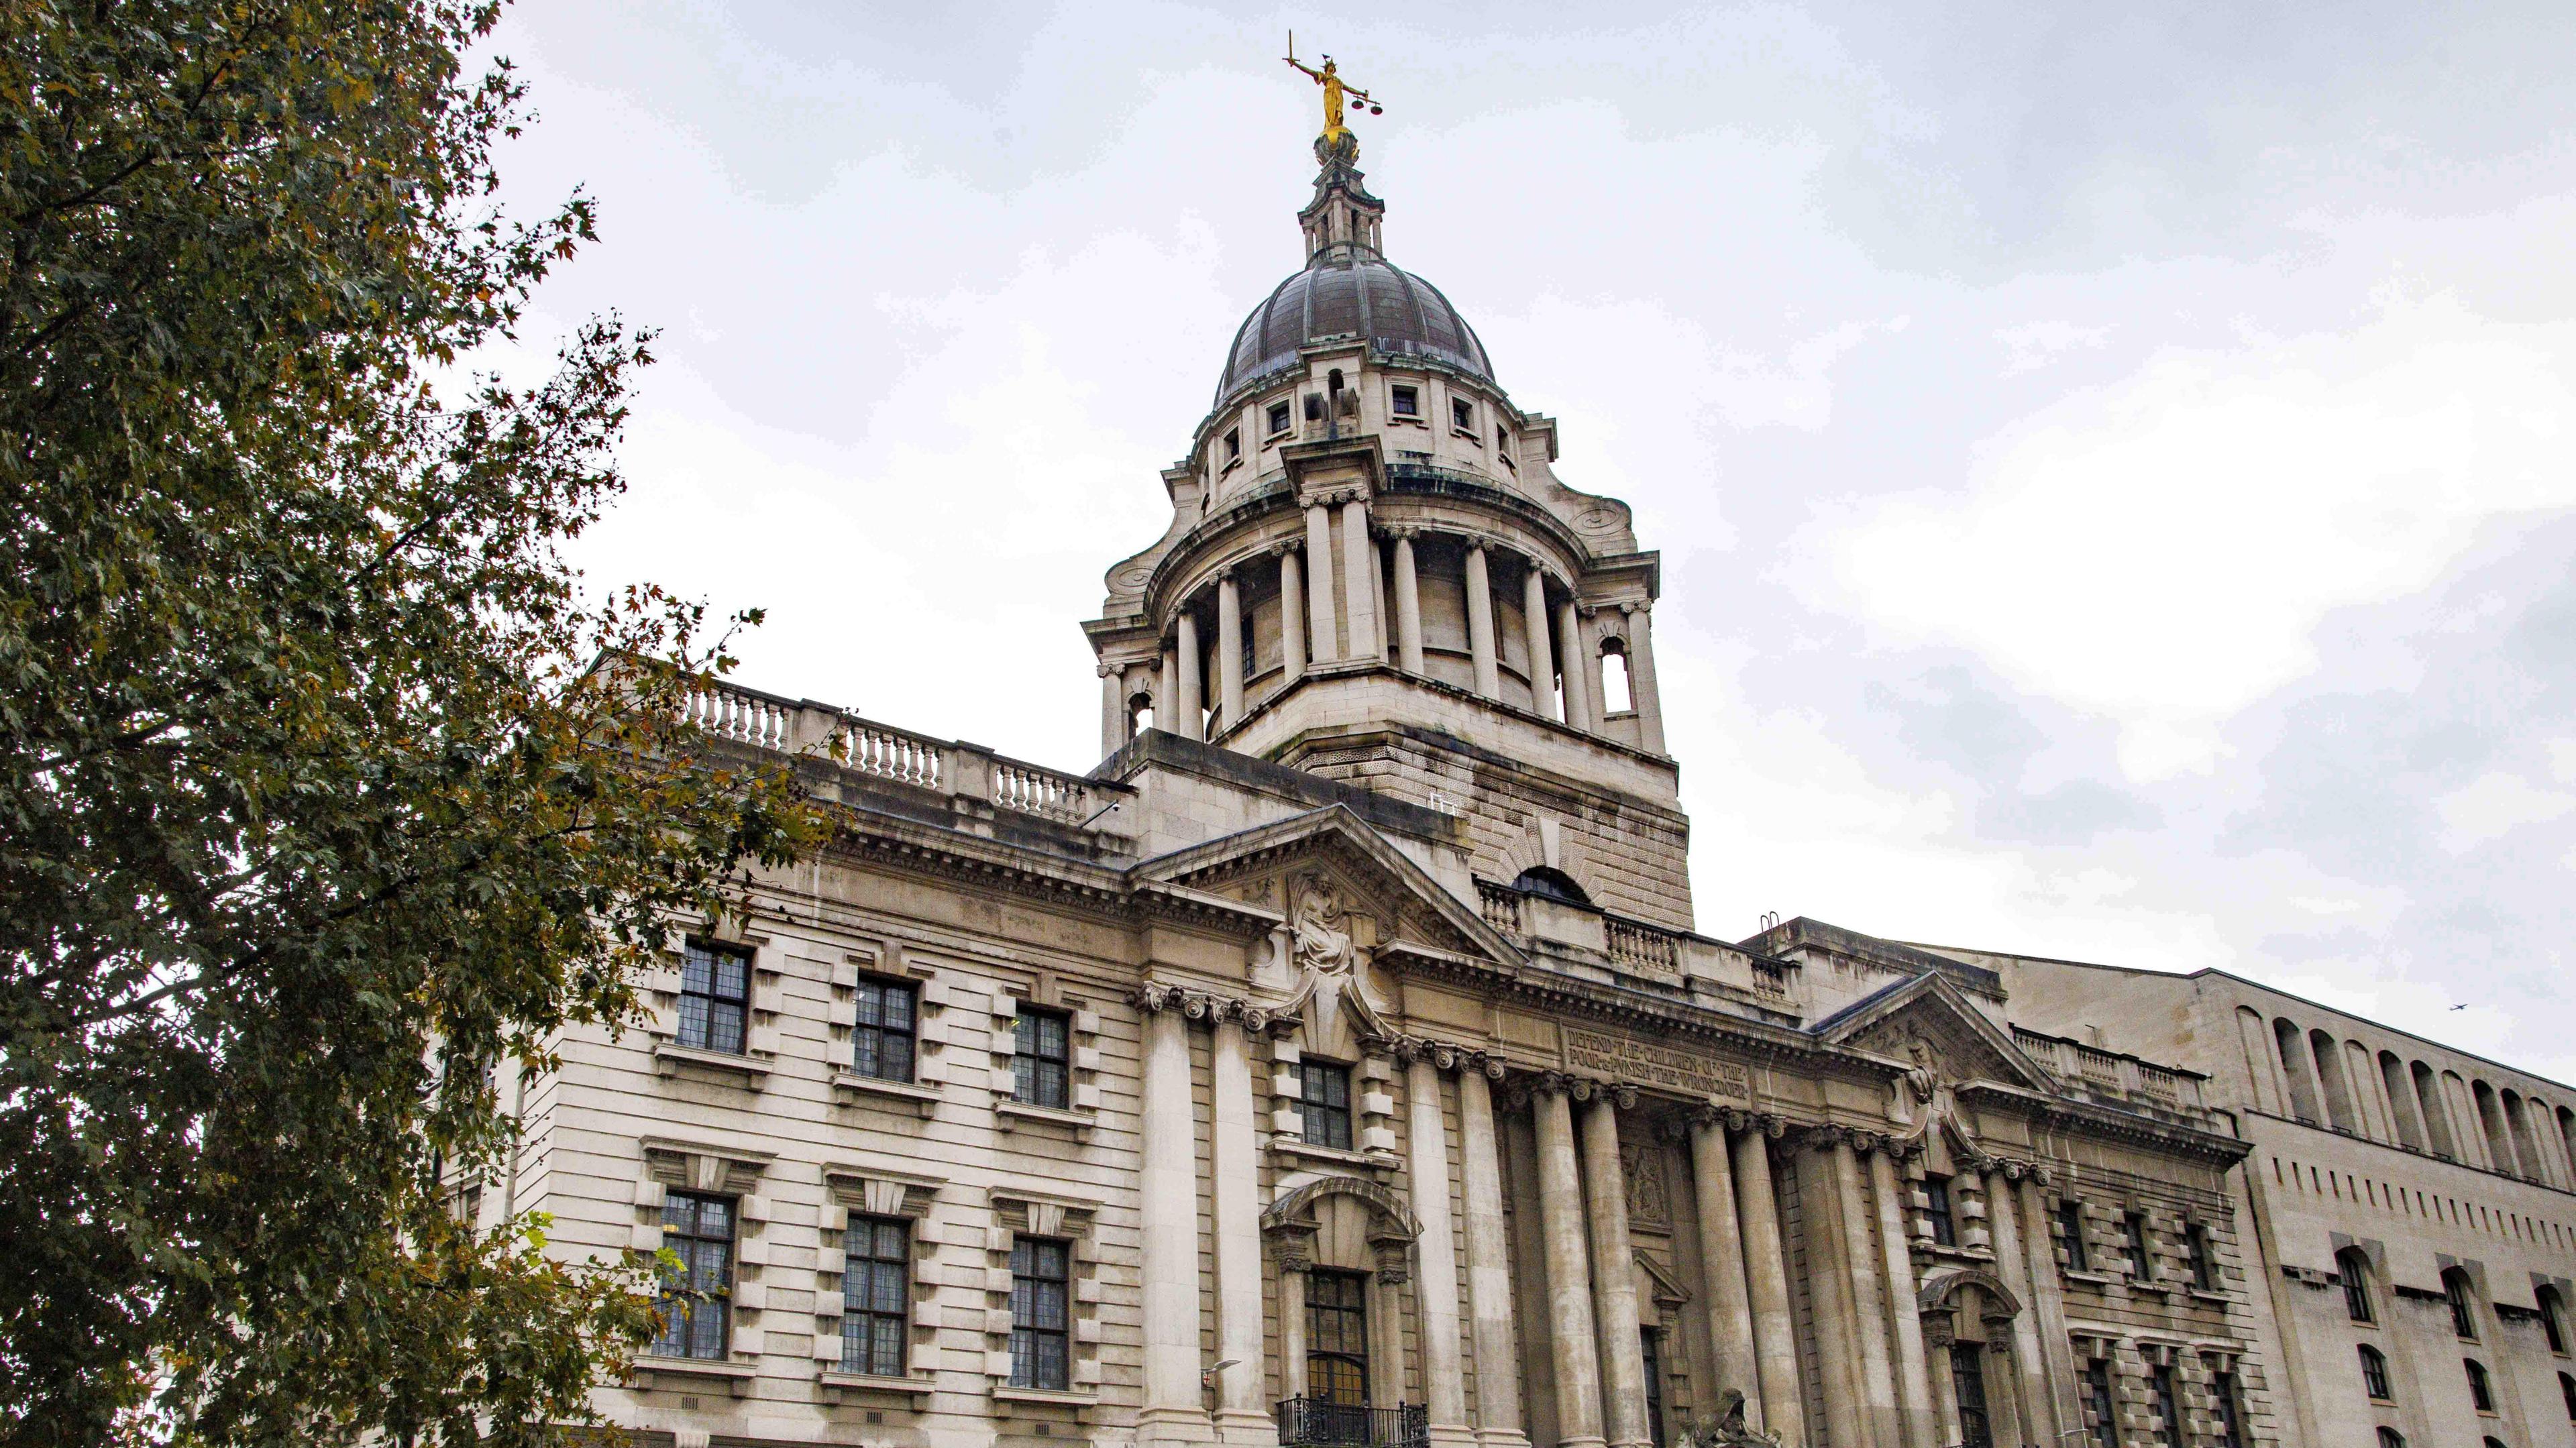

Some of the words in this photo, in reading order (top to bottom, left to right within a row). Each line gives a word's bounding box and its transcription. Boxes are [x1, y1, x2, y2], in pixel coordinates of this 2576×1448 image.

[1568, 1030, 1611, 1053] DEFEND
[1615, 1040, 1640, 1060] THE
[1644, 1046, 1698, 1072] CHILDREN
[1702, 1060, 1717, 1076] OF
[1720, 1063, 1743, 1082] THE
[1569, 1048, 1601, 1070] POOR
[1654, 1066, 1676, 1085] THE
[1678, 1071, 1746, 1100] WRONGDOER
